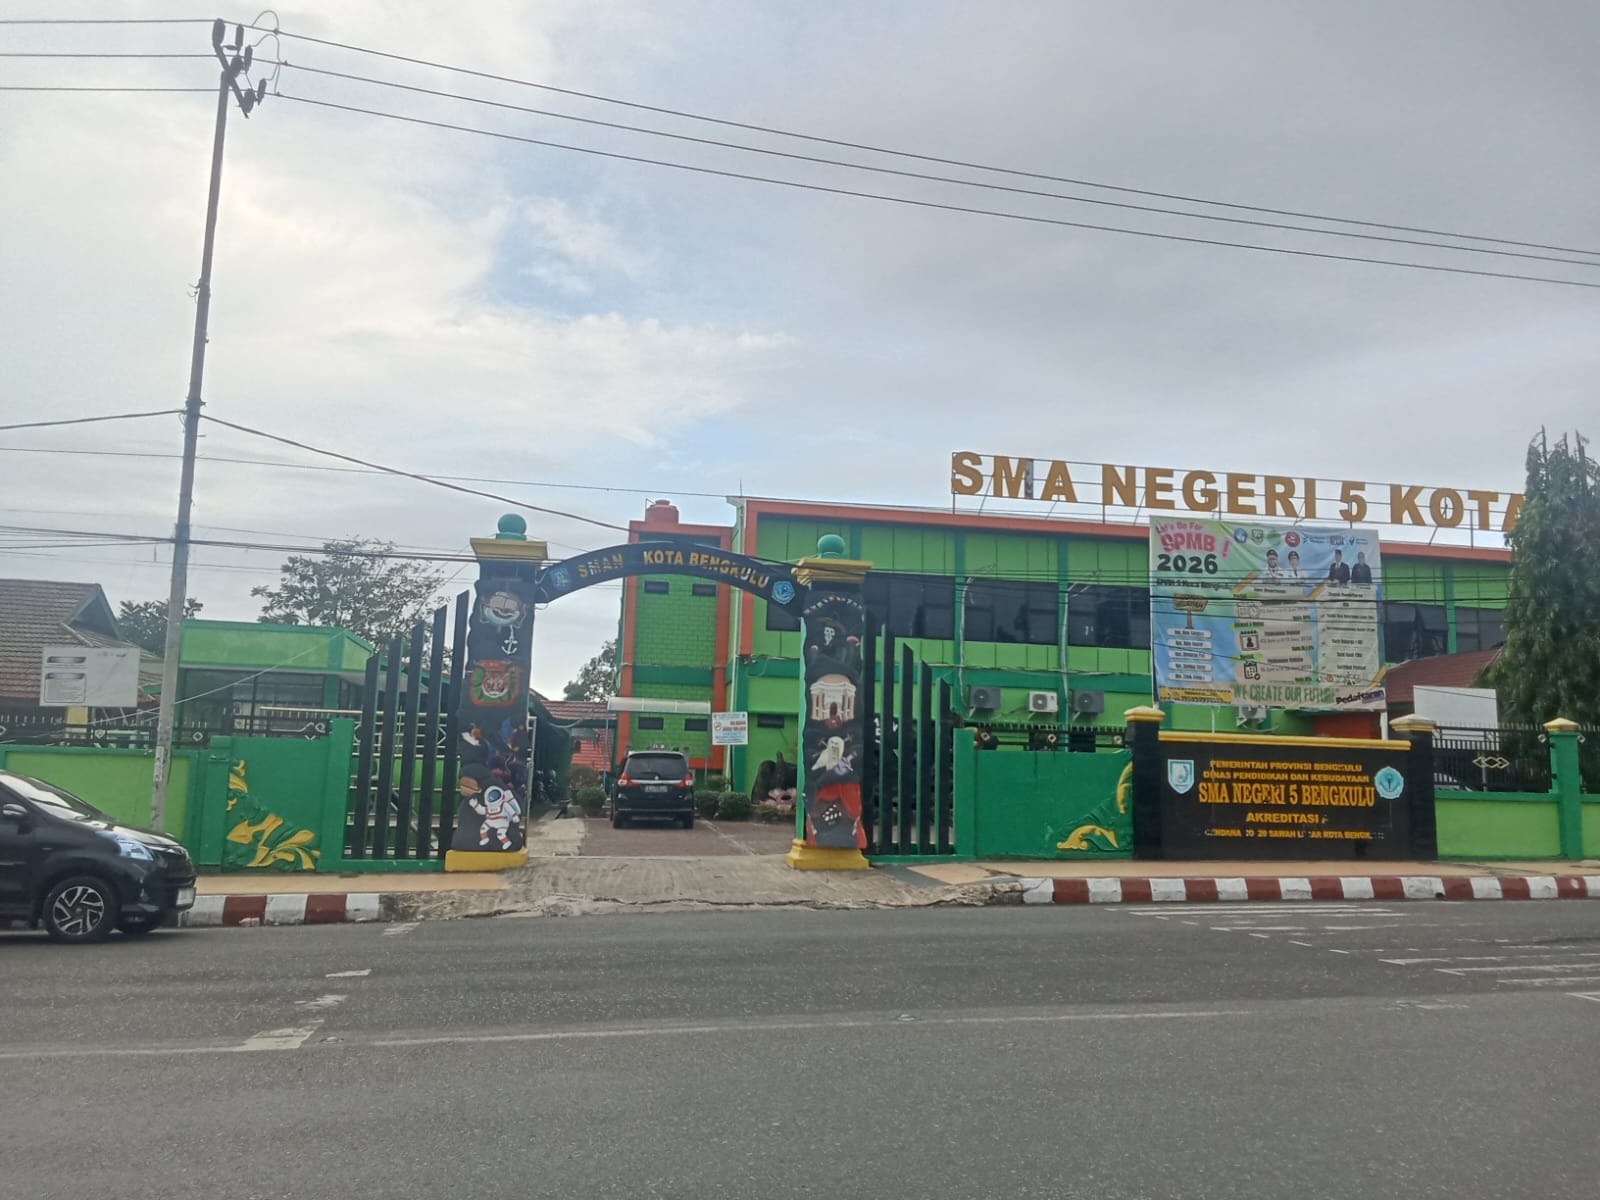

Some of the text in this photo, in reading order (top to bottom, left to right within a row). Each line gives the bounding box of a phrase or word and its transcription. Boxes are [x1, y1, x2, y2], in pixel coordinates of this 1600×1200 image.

[951, 450, 1078, 503] SMA
[1102, 463, 1316, 519] NEGERI
[1338, 481, 1367, 522] 5
[1161, 532, 1216, 552] SPMB
[643, 550, 684, 565] KOTA
[689, 552, 770, 588] BENGKULU
[1157, 553, 1218, 575] 2026
[1250, 686, 1282, 702] CREATE
[1284, 688, 1301, 703] OUR
[1210, 760, 1268, 769] PEMERINTAH
[1270, 762, 1312, 770] PROVINSI
[1203, 771, 1231, 779] DINAS
[1233, 772, 1288, 780] PENDIDIKAN
[1310, 774, 1369, 782] KEBUDAYAAN
[1199, 782, 1375, 807] SMA NEGERI 5 BENGKULU
[1246, 812, 1319, 823] AKREDITASI
